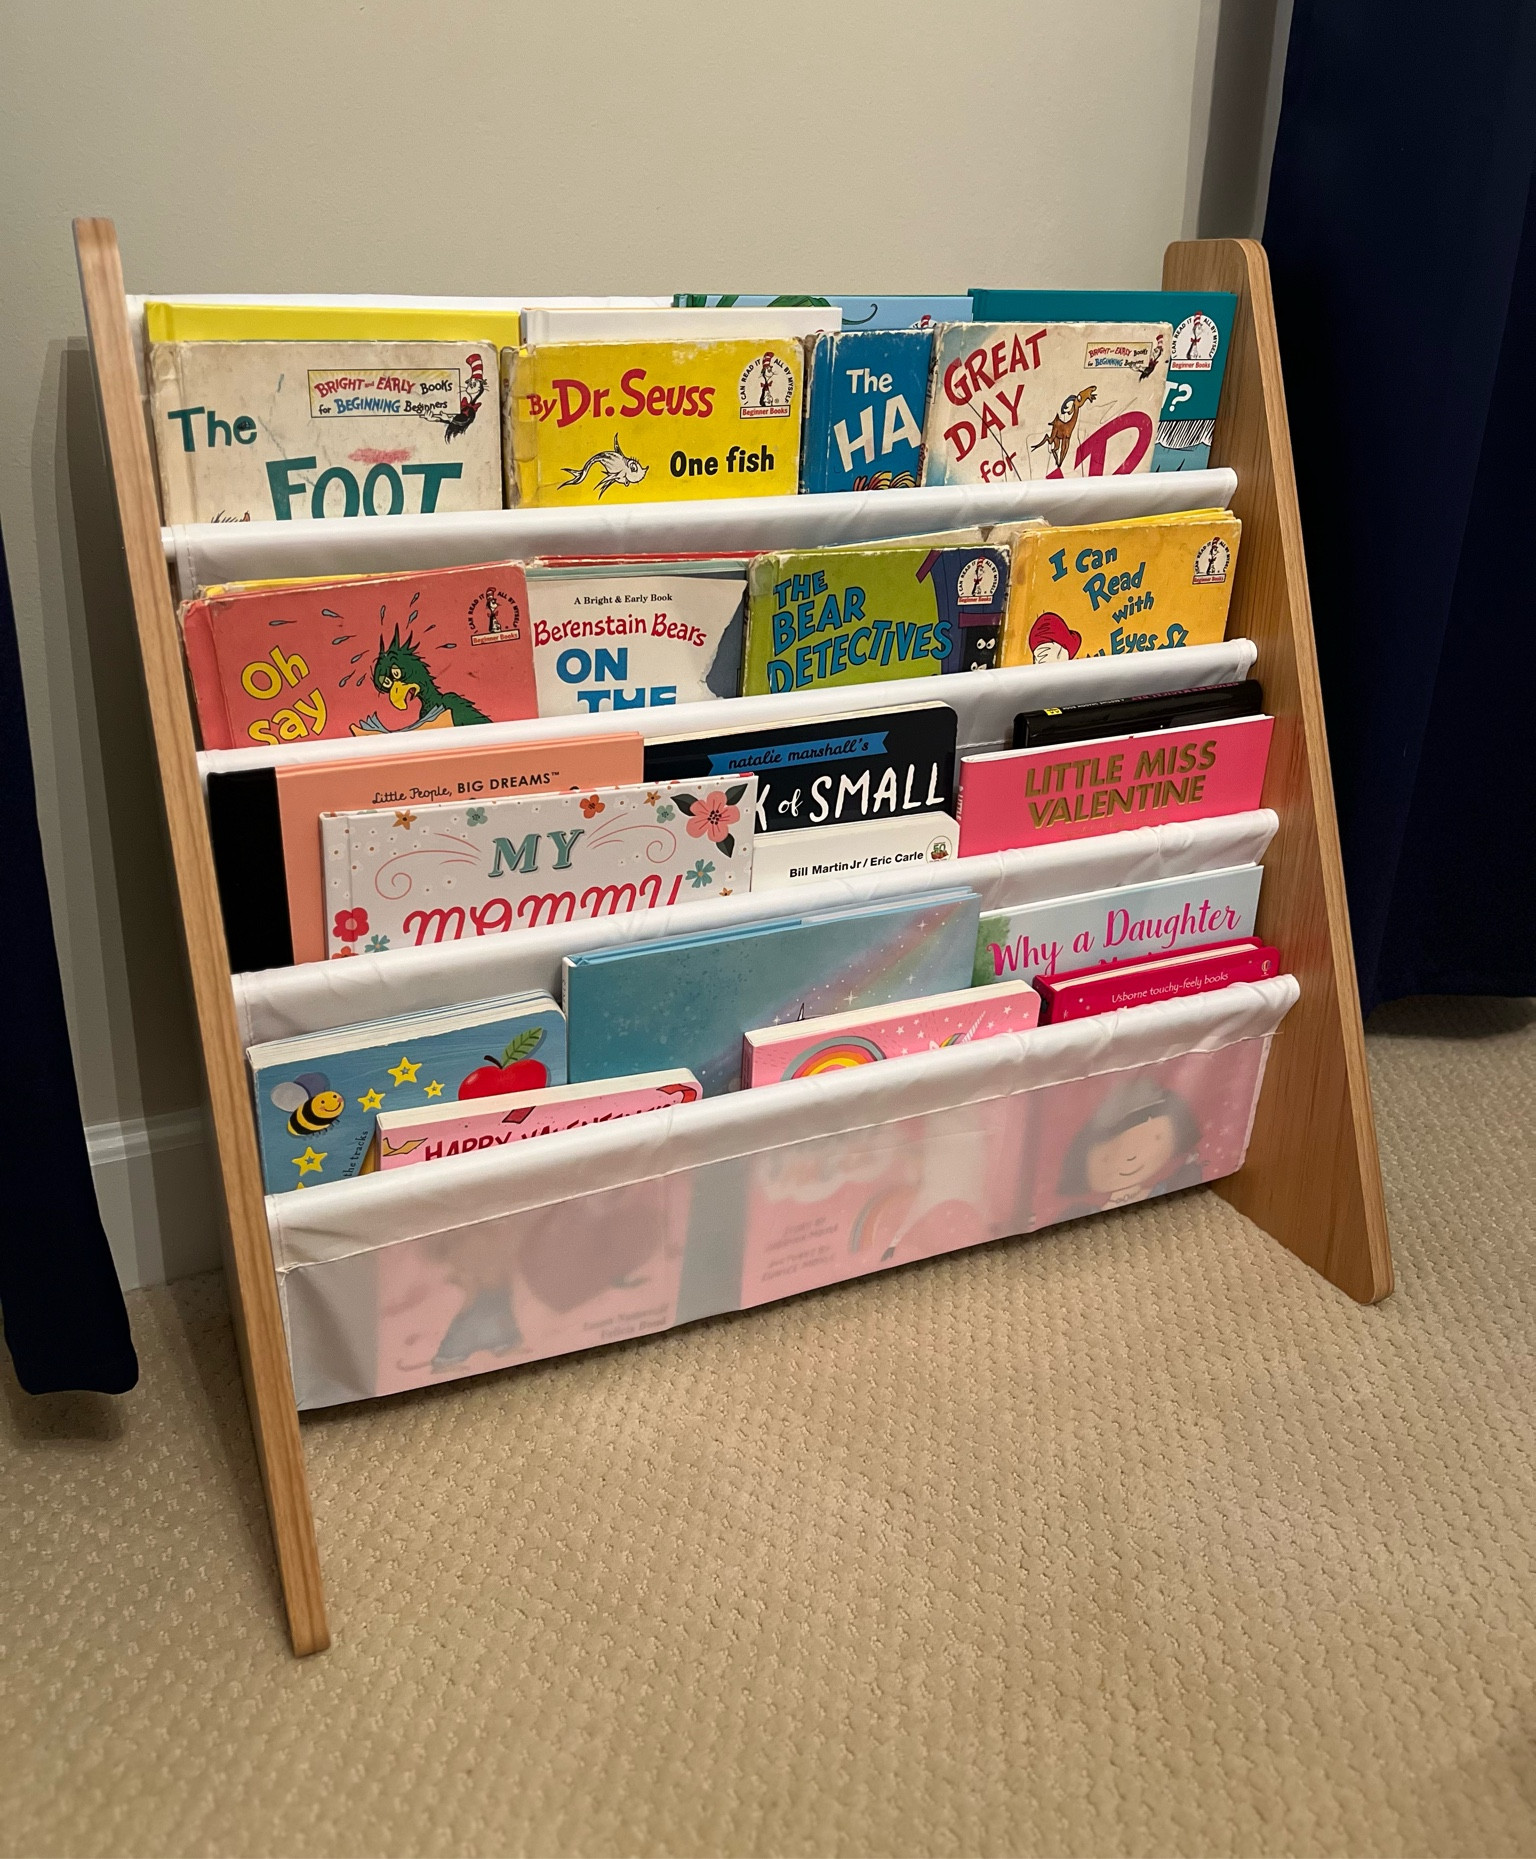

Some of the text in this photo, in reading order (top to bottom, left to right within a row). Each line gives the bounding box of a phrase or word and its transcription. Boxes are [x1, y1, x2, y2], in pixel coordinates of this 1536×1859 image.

[1173, 323, 1187, 339] READ
[1203, 318, 1212, 328] ALL
[1210, 325, 1217, 334] BY
[754, 358, 761, 366] IT
[1088, 347, 1111, 358] BRIGHT
[1114, 347, 1132, 356] EARLY
[1208, 334, 1218, 358] MYSELF
[741, 364, 755, 382] READ
[773, 358, 785, 369] ALL
[783, 366, 792, 375] BY
[943, 329, 1049, 407] GREAT
[1171, 361, 1210, 370] Beginner Books
[314, 377, 366, 398] BRIGHT
[376, 376, 417, 395] EARLY
[526, 368, 716, 428] By Dr. Seuss
[785, 376, 794, 404] MYSELF
[846, 368, 893, 396] The
[319, 397, 448, 415] for BEGINNING Beginners
[742, 407, 788, 417] Beginner Books
[168, 406, 257, 452] The
[943, 385, 1025, 462] DAY
[670, 445, 775, 478] One fish
[980, 451, 1018, 484] for
[265, 456, 463, 521] FOOT
[1048, 547, 1118, 582] I Can
[497, 591, 507, 600] ALL
[574, 593, 673, 606] A Bright & Early Book
[773, 570, 828, 610] THE
[1083, 562, 1146, 611] Read
[772, 586, 866, 656] BEAR
[1112, 591, 1155, 624] with
[473, 632, 518, 644] Beginner Books
[533, 614, 647, 648] Berenstain
[651, 613, 707, 647] Bears
[1110, 626, 1158, 655] Eyes
[241, 645, 310, 700] Oh
[556, 647, 628, 684] ON
[767, 621, 953, 693] DETECTIVES
[248, 688, 328, 745] say
[728, 738, 870, 771] natalie marshall's
[1024, 740, 1217, 798] LITTLE MISS
[372, 792, 407, 805] Little
[409, 786, 453, 802] People,
[457, 780, 484, 793] BIG
[778, 788, 803, 818] of
[809, 762, 946, 823] SMALL
[1028, 775, 1206, 829] VALENTINE
[488, 829, 586, 878] MY
[789, 867, 808, 878] Bill
[812, 862, 849, 875] Martin
[850, 860, 862, 870] Jr
[870, 856, 892, 867] Eric
[894, 851, 924, 863] Carle
[986, 899, 1242, 977] Why a Daughter
[1111, 972, 1229, 1004] Usborne touchy-feely books
[342, 1131, 369, 1177] the tracks
[425, 1131, 512, 1162] HAPPY
